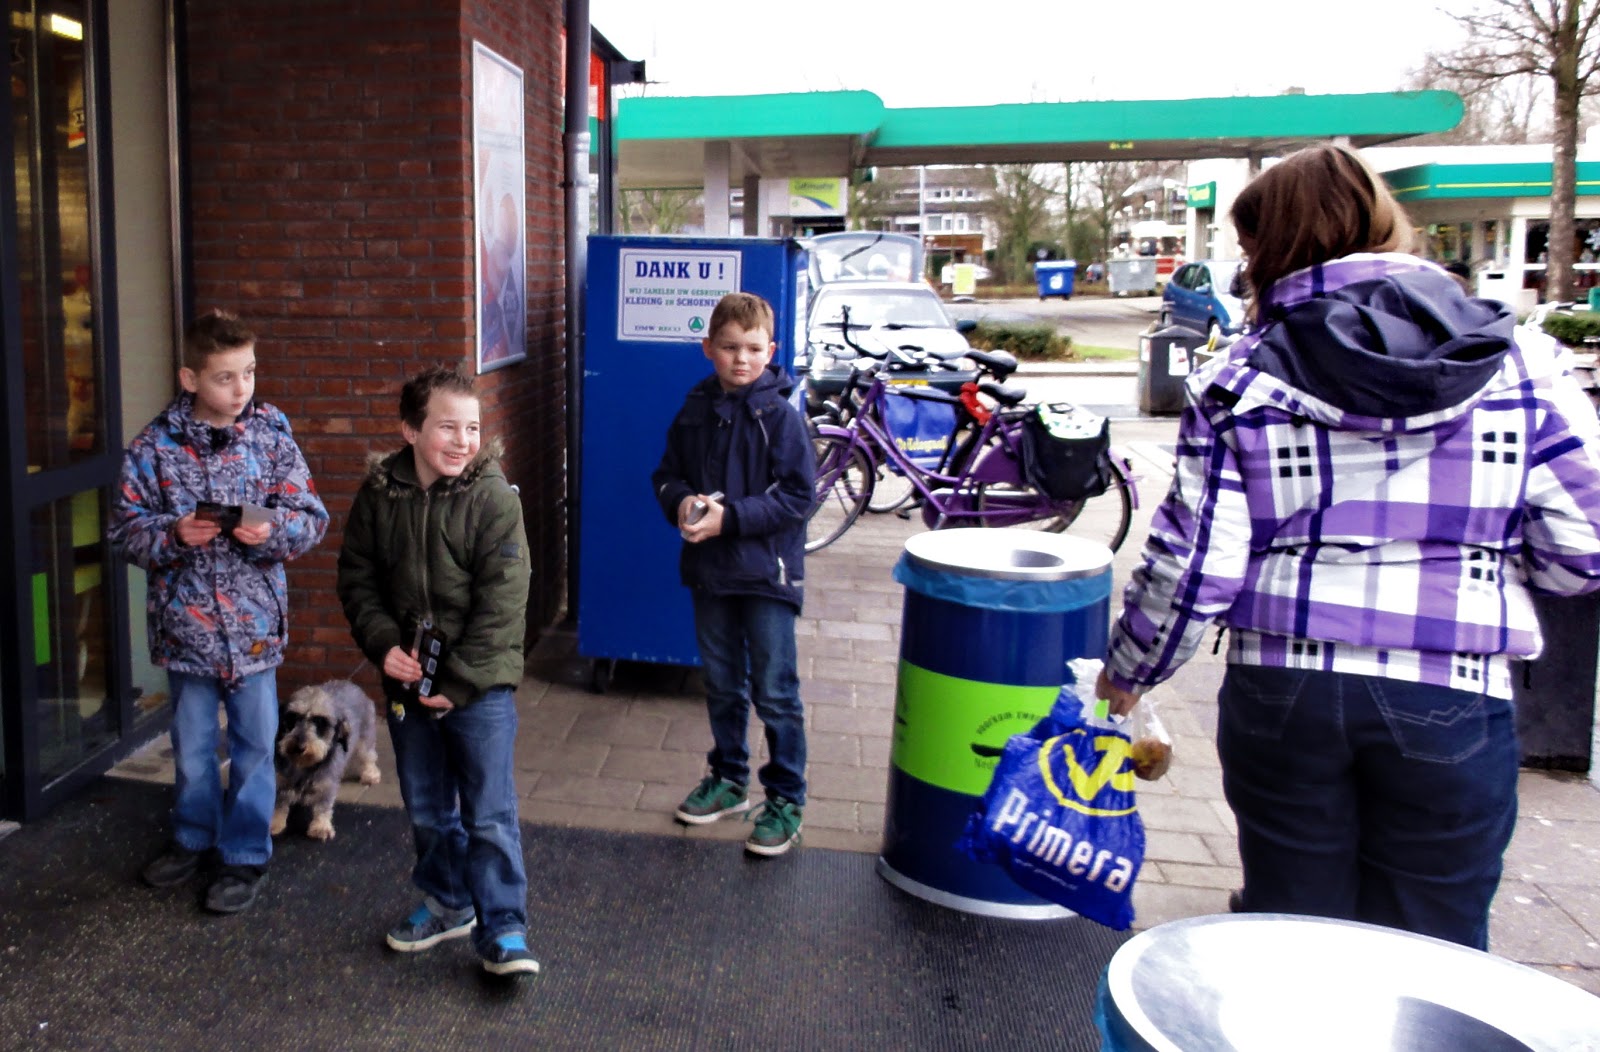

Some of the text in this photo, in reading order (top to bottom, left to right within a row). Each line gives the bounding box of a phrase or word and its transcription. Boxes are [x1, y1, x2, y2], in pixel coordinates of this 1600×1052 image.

[635, 260, 690, 279] DANK
[698, 262, 711, 280] U
[625, 296, 662, 305] KLEDING
[991, 787, 1134, 893] Primera
